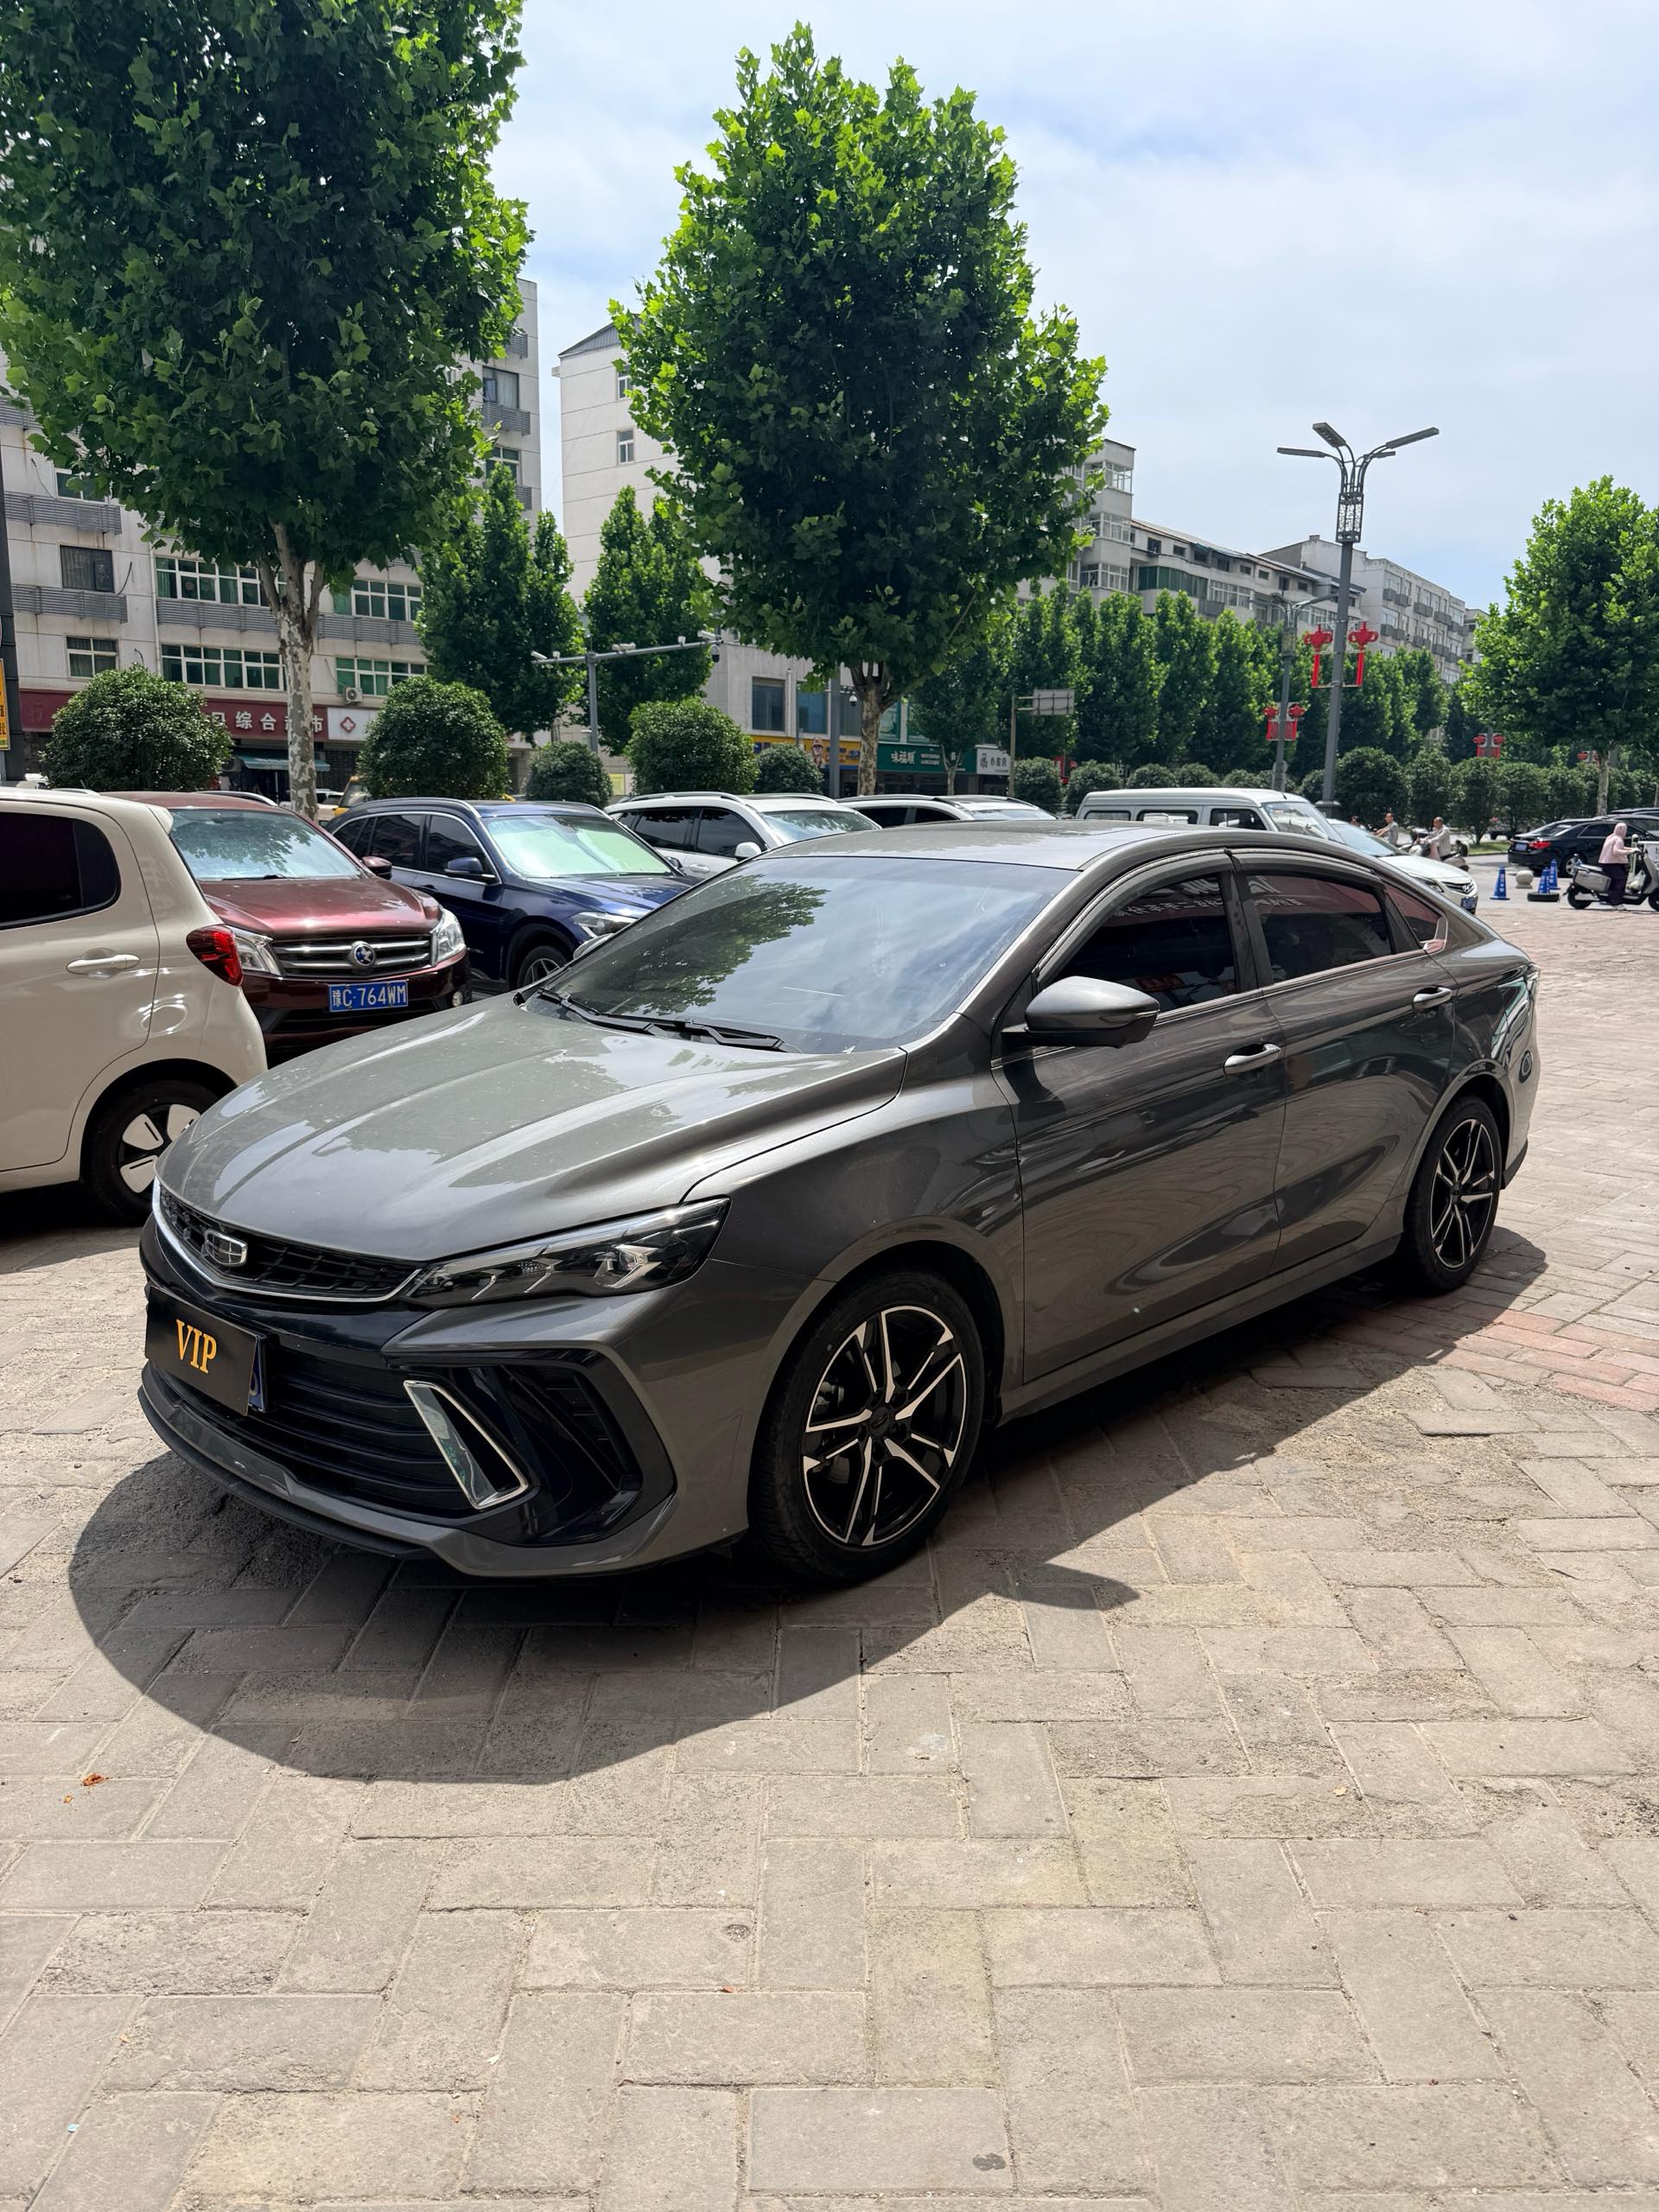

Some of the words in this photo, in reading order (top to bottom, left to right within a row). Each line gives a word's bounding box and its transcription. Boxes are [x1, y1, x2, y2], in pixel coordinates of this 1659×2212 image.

[211, 711, 323, 733] 综合市
[175, 1319, 217, 1374] VIP
